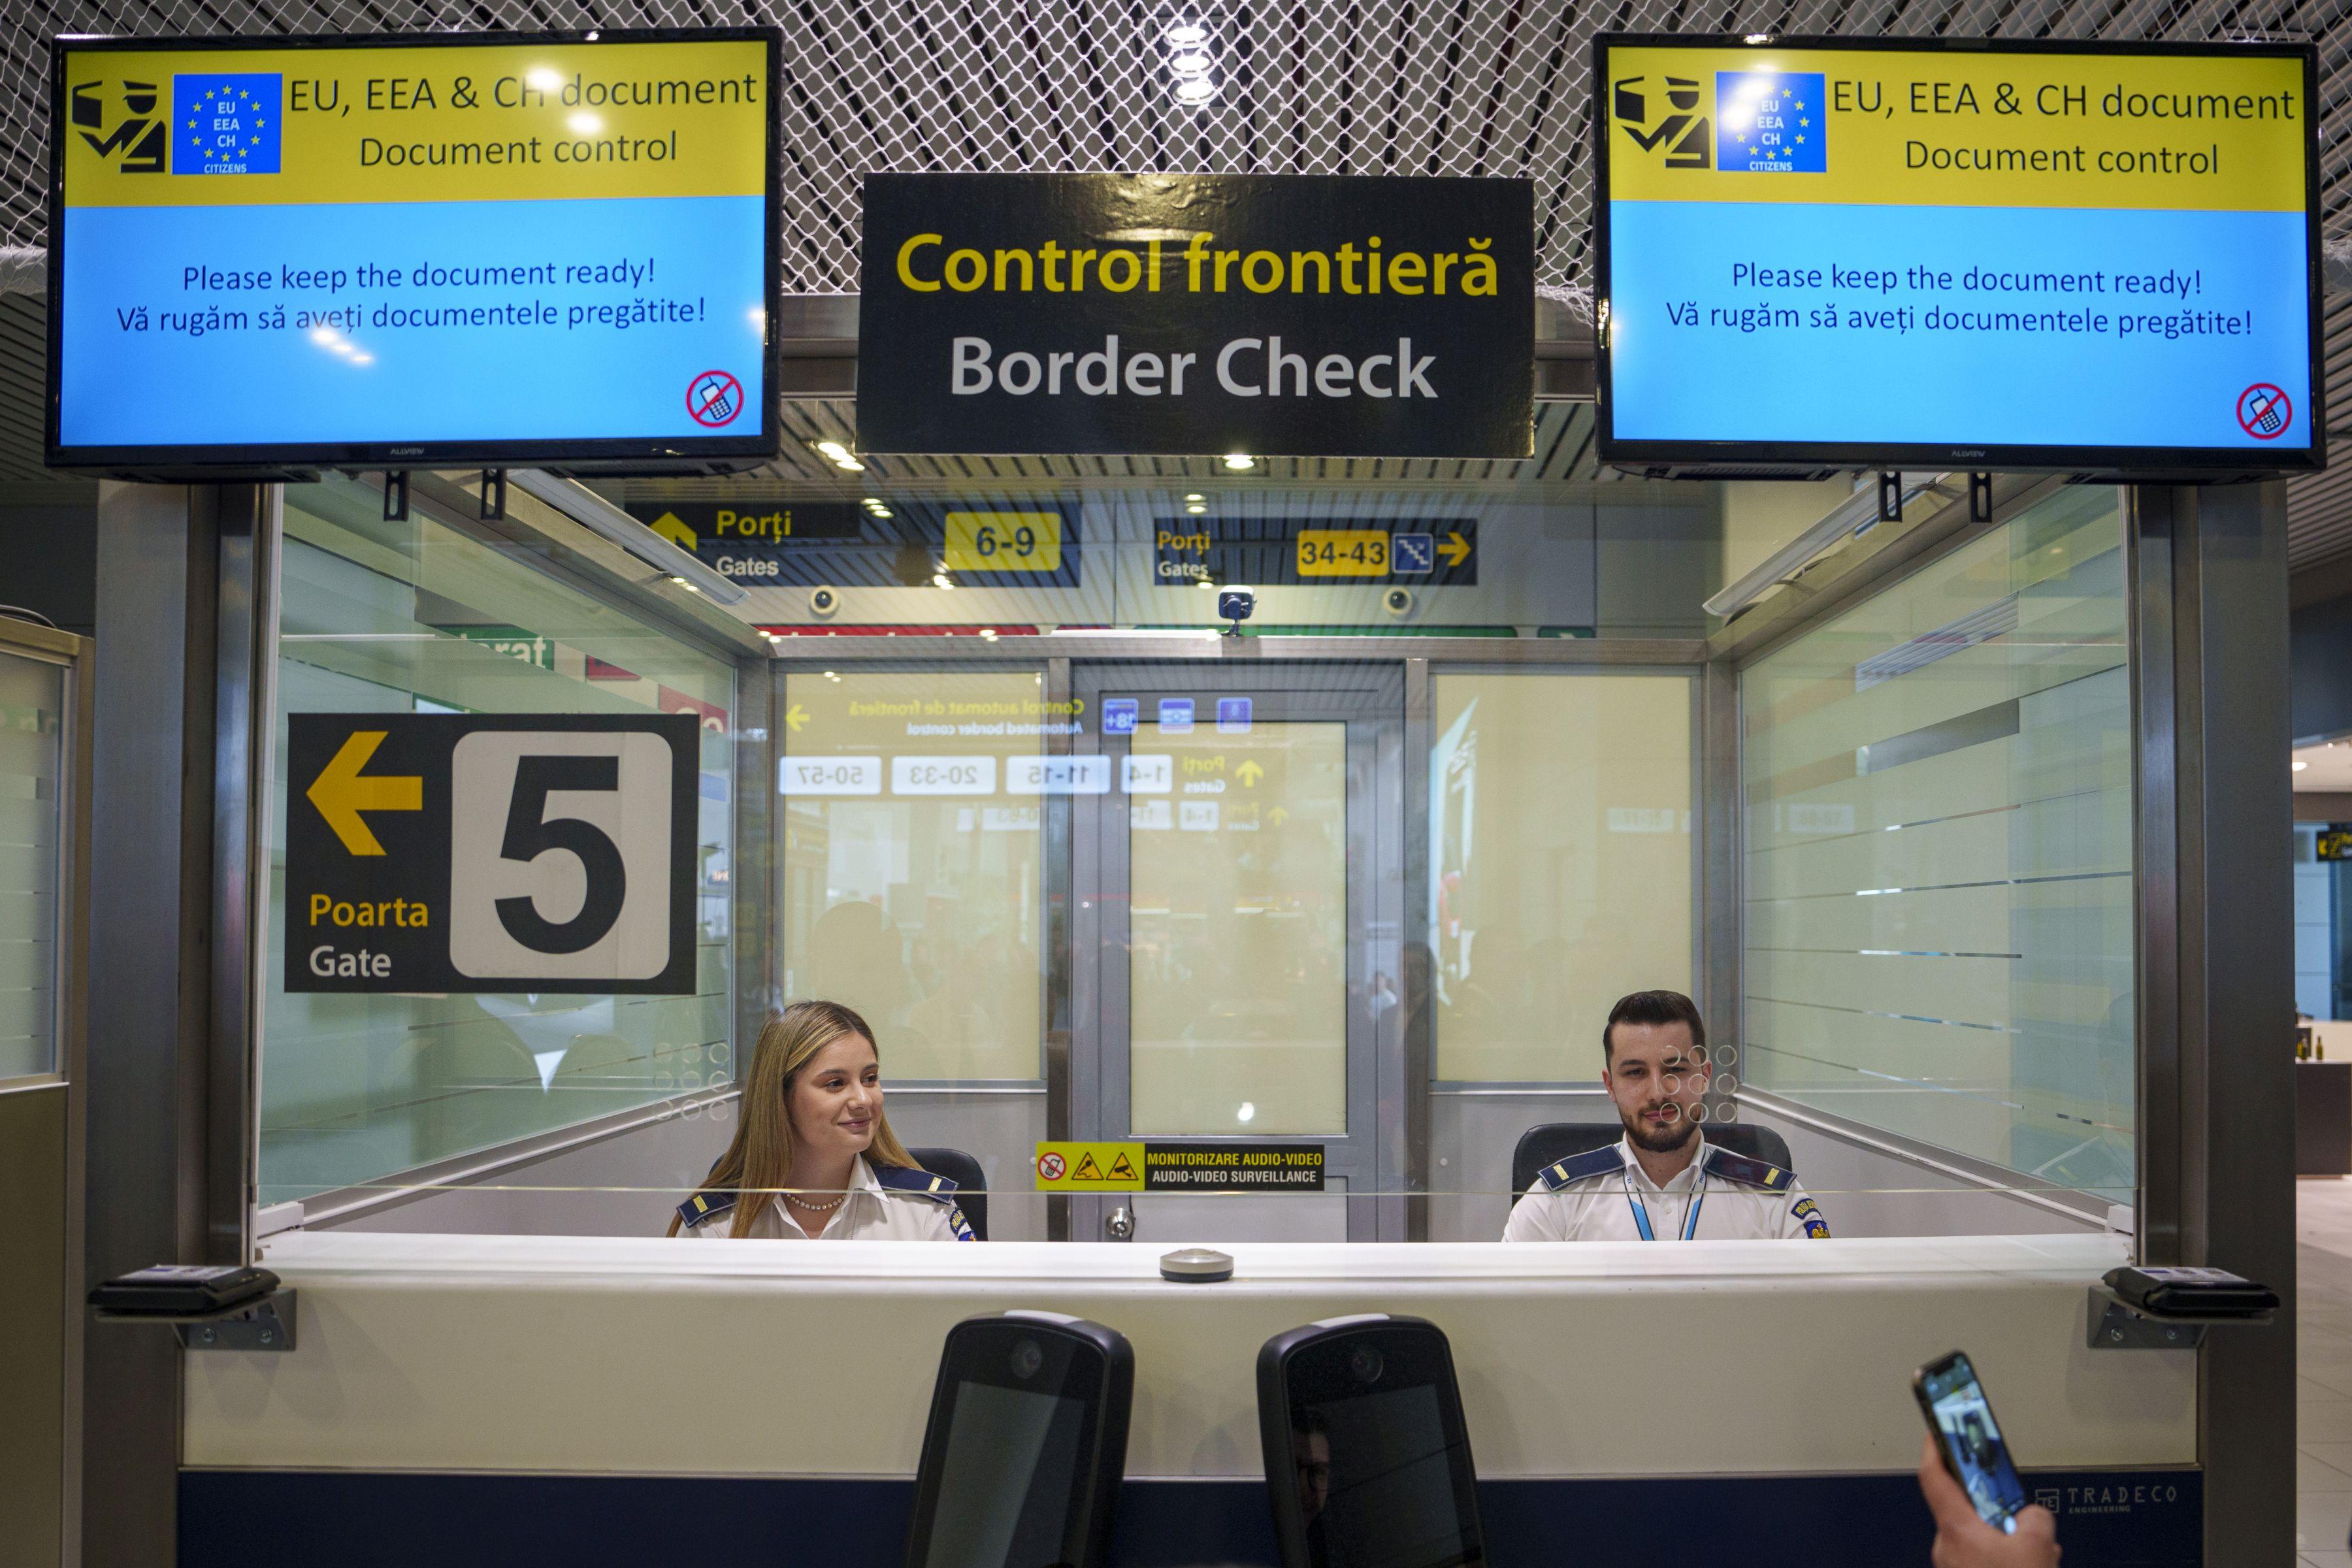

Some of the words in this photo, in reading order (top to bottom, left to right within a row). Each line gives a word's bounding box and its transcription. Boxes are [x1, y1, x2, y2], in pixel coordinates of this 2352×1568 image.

[291, 80, 350, 117] EU,
[367, 78, 436, 110] EEA
[451, 76, 479, 108] &
[495, 76, 544, 107] CH
[561, 71, 758, 106] document
[1761, 100, 1779, 112] EU
[1835, 81, 1893, 119] EU,
[1911, 82, 1980, 114] EEA
[1994, 83, 2022, 114] &
[2037, 85, 2085, 116] CH
[2102, 84, 2294, 120] document
[218, 102, 235, 114] EU
[214, 119, 239, 130] EEA
[1757, 116, 1784, 129] EEA
[218, 135, 235, 147] CH
[361, 138, 540, 166] Document
[555, 129, 677, 163] control
[1761, 133, 1781, 145] CH
[204, 163, 247, 173] CITIZENS
[1749, 161, 1793, 171] CITIZENS
[1906, 141, 2085, 172] Document
[2099, 144, 2217, 174] control
[184, 265, 271, 290] Please
[283, 264, 346, 293] keep
[357, 263, 401, 287] the
[413, 262, 555, 286] document
[567, 258, 653, 288] ready!
[897, 233, 1161, 292] Control
[1184, 231, 1497, 295] frontieră
[1734, 262, 1821, 287] Please
[1833, 263, 1897, 295] keep
[1907, 265, 1952, 289] the
[1964, 266, 2104, 292] document
[2115, 269, 2200, 300] ready!
[118, 306, 148, 331] Vă
[161, 306, 247, 336] rugăm
[259, 304, 285, 329] să
[297, 304, 361, 333] aveți
[373, 300, 557, 327] documentele
[569, 297, 704, 329] pregătite!
[1667, 302, 1698, 325] Vă
[1712, 302, 1799, 333] rugăm
[1810, 303, 1837, 328] să
[1849, 306, 1913, 335] aveți
[1925, 305, 2108, 333] documentele
[2119, 310, 2251, 339] pregătite!
[952, 335, 1196, 395] Border
[1217, 336, 1438, 397] Check
[716, 510, 791, 544] Porți
[977, 527, 1035, 556] 6-9
[1302, 542, 1384, 564] 34-43
[717, 556, 779, 576] Gates
[1158, 561, 1209, 576] Gates
[495, 755, 626, 954] 5
[311, 894, 428, 926] Poarta
[310, 945, 391, 977] Gate
[1147, 1153, 1239, 1166] MONITORIZARE
[1243, 1153, 1322, 1166] AUDIO-VIDEO
[1152, 1171, 1228, 1183] AUDIO-VIDEO
[1231, 1171, 1316, 1183] SURVEILLANCE
[2067, 1486, 2178, 1503] TRADECO
[2068, 1505, 2131, 1514] ENGINEERING
